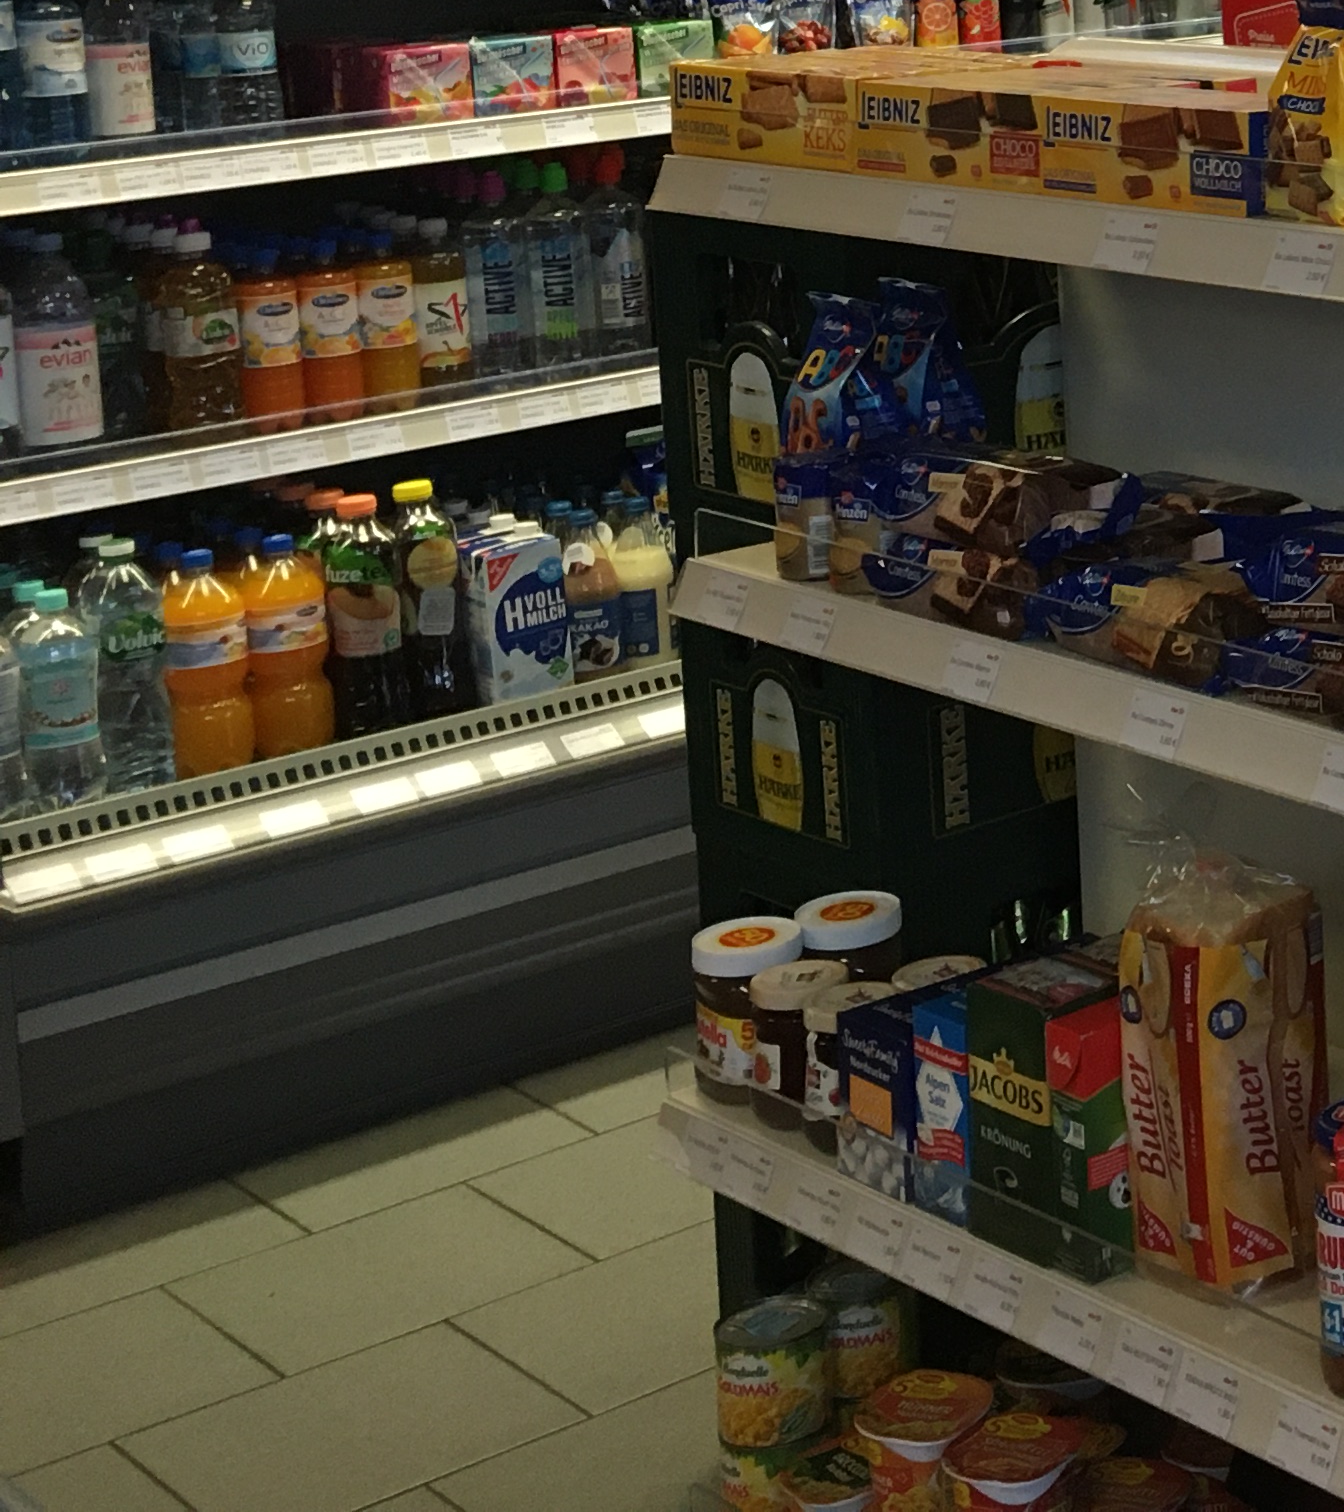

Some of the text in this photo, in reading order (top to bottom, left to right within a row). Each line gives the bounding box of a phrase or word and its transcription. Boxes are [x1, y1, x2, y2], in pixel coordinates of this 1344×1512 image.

[675, 66, 733, 109] LEIBNIZ
[857, 90, 921, 129] LEIBNIZ
[1043, 105, 1112, 148] LEIBNIZ
[803, 127, 847, 153] KEKS
[991, 138, 1037, 157] CHOCO
[1192, 157, 1243, 179] CHOCO
[482, 260, 517, 315] ACTIVE
[541, 253, 575, 307] ACTIVE
[39, 346, 93, 369] evian
[503, 588, 566, 632] H VOLL
[526, 603, 568, 626] MILCH
[106, 625, 166, 655] Volvic
[1311, 646, 1343, 663] Schoko
[925, 1072, 950, 1093] Alpen
[928, 1090, 947, 1109] Salz
[969, 1065, 1045, 1116] JACOBS
[1127, 1052, 1168, 1180] Butter
[1237, 1058, 1282, 1176] Butter
[980, 1124, 1033, 1160] KRÖNUNG
